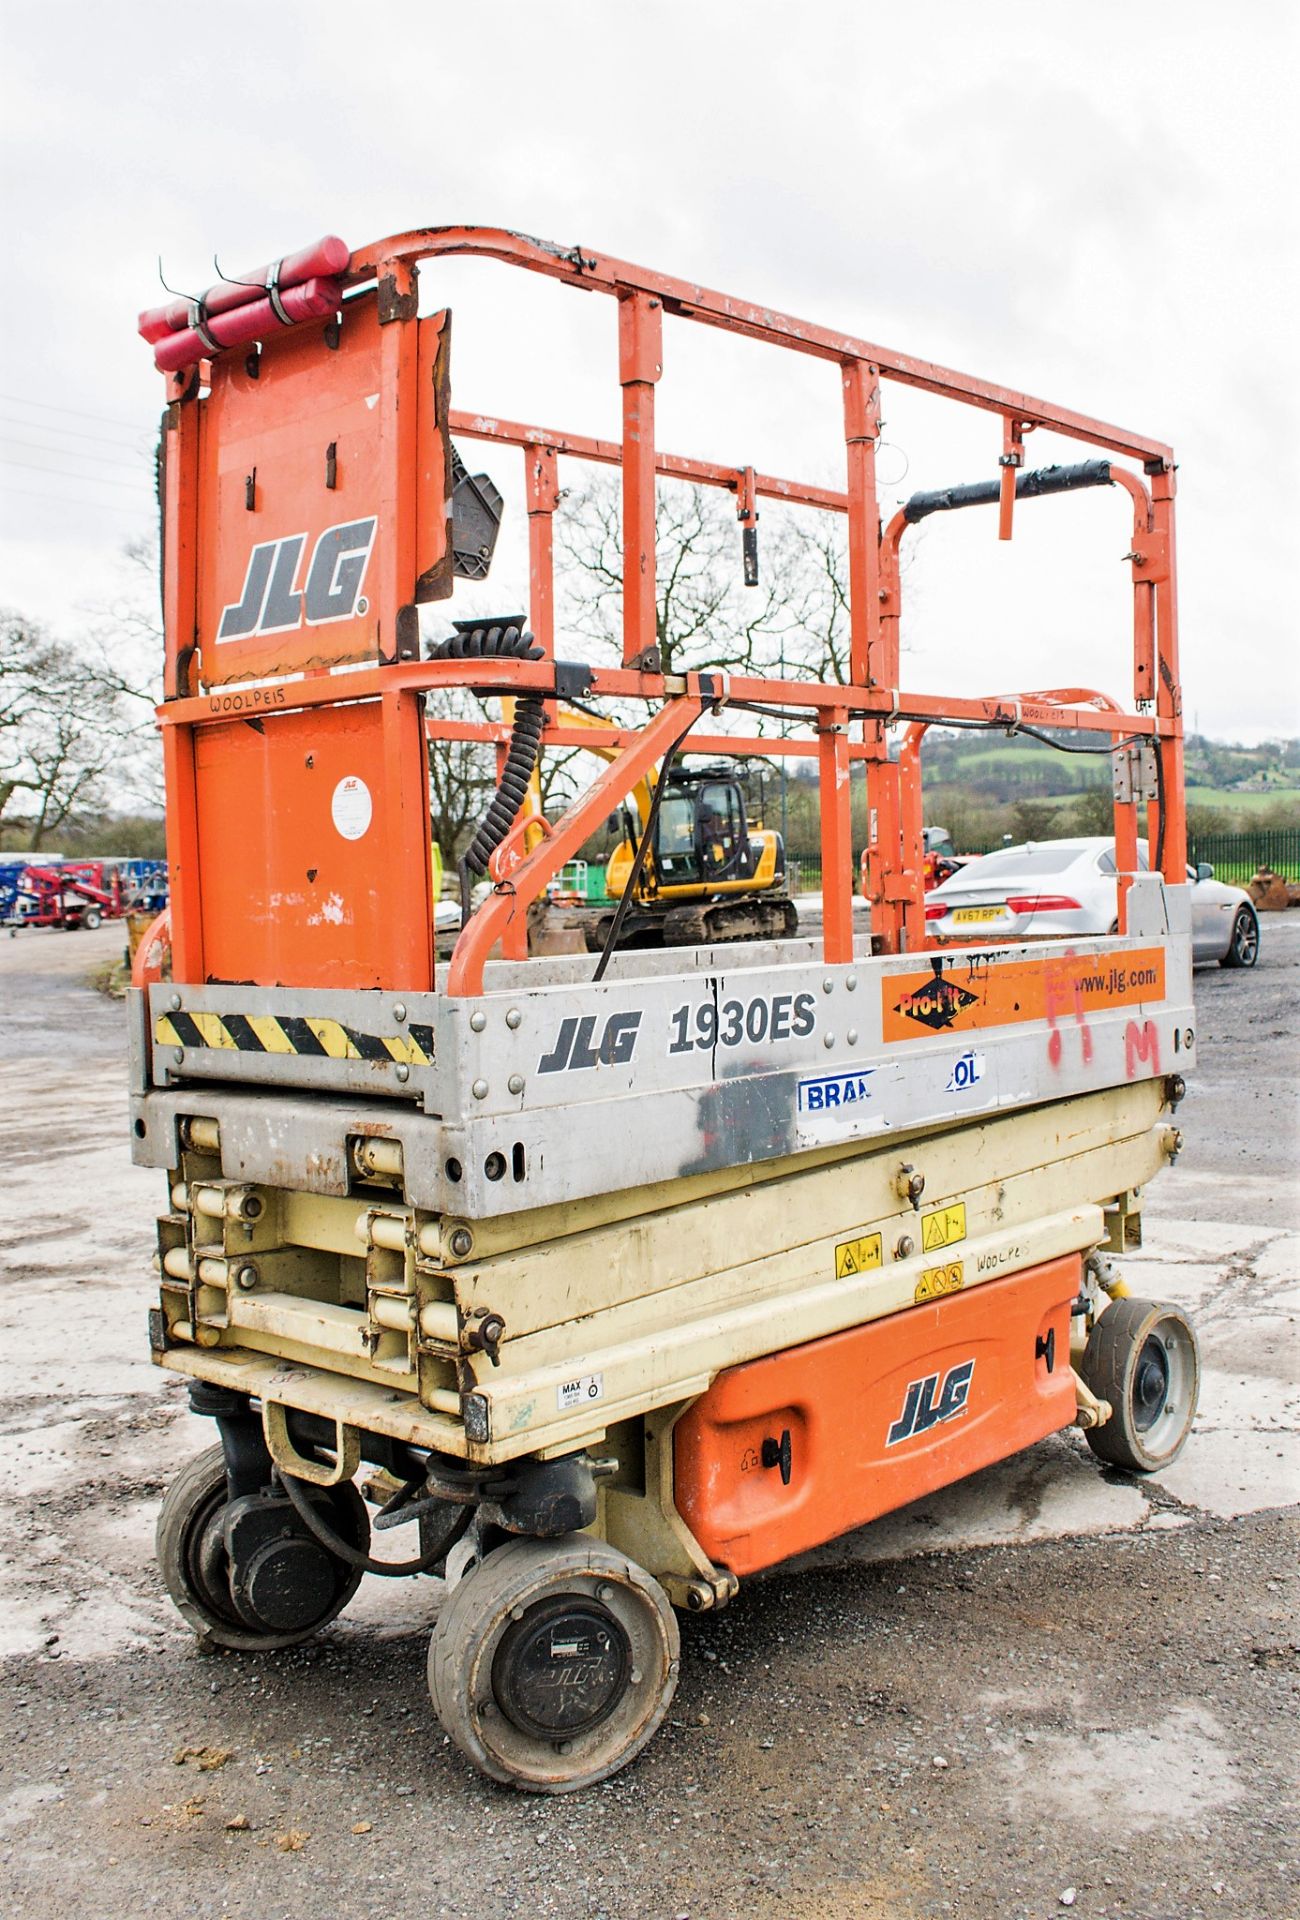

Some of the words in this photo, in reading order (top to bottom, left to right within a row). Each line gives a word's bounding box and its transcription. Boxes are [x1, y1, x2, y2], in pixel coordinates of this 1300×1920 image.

[216, 515, 378, 644] JLG
[537, 1010, 643, 1075] JLG
[668, 993, 817, 1055] 1930ES
[562, 1381, 581, 1394] MAX
[885, 1358, 976, 1448] JLG
